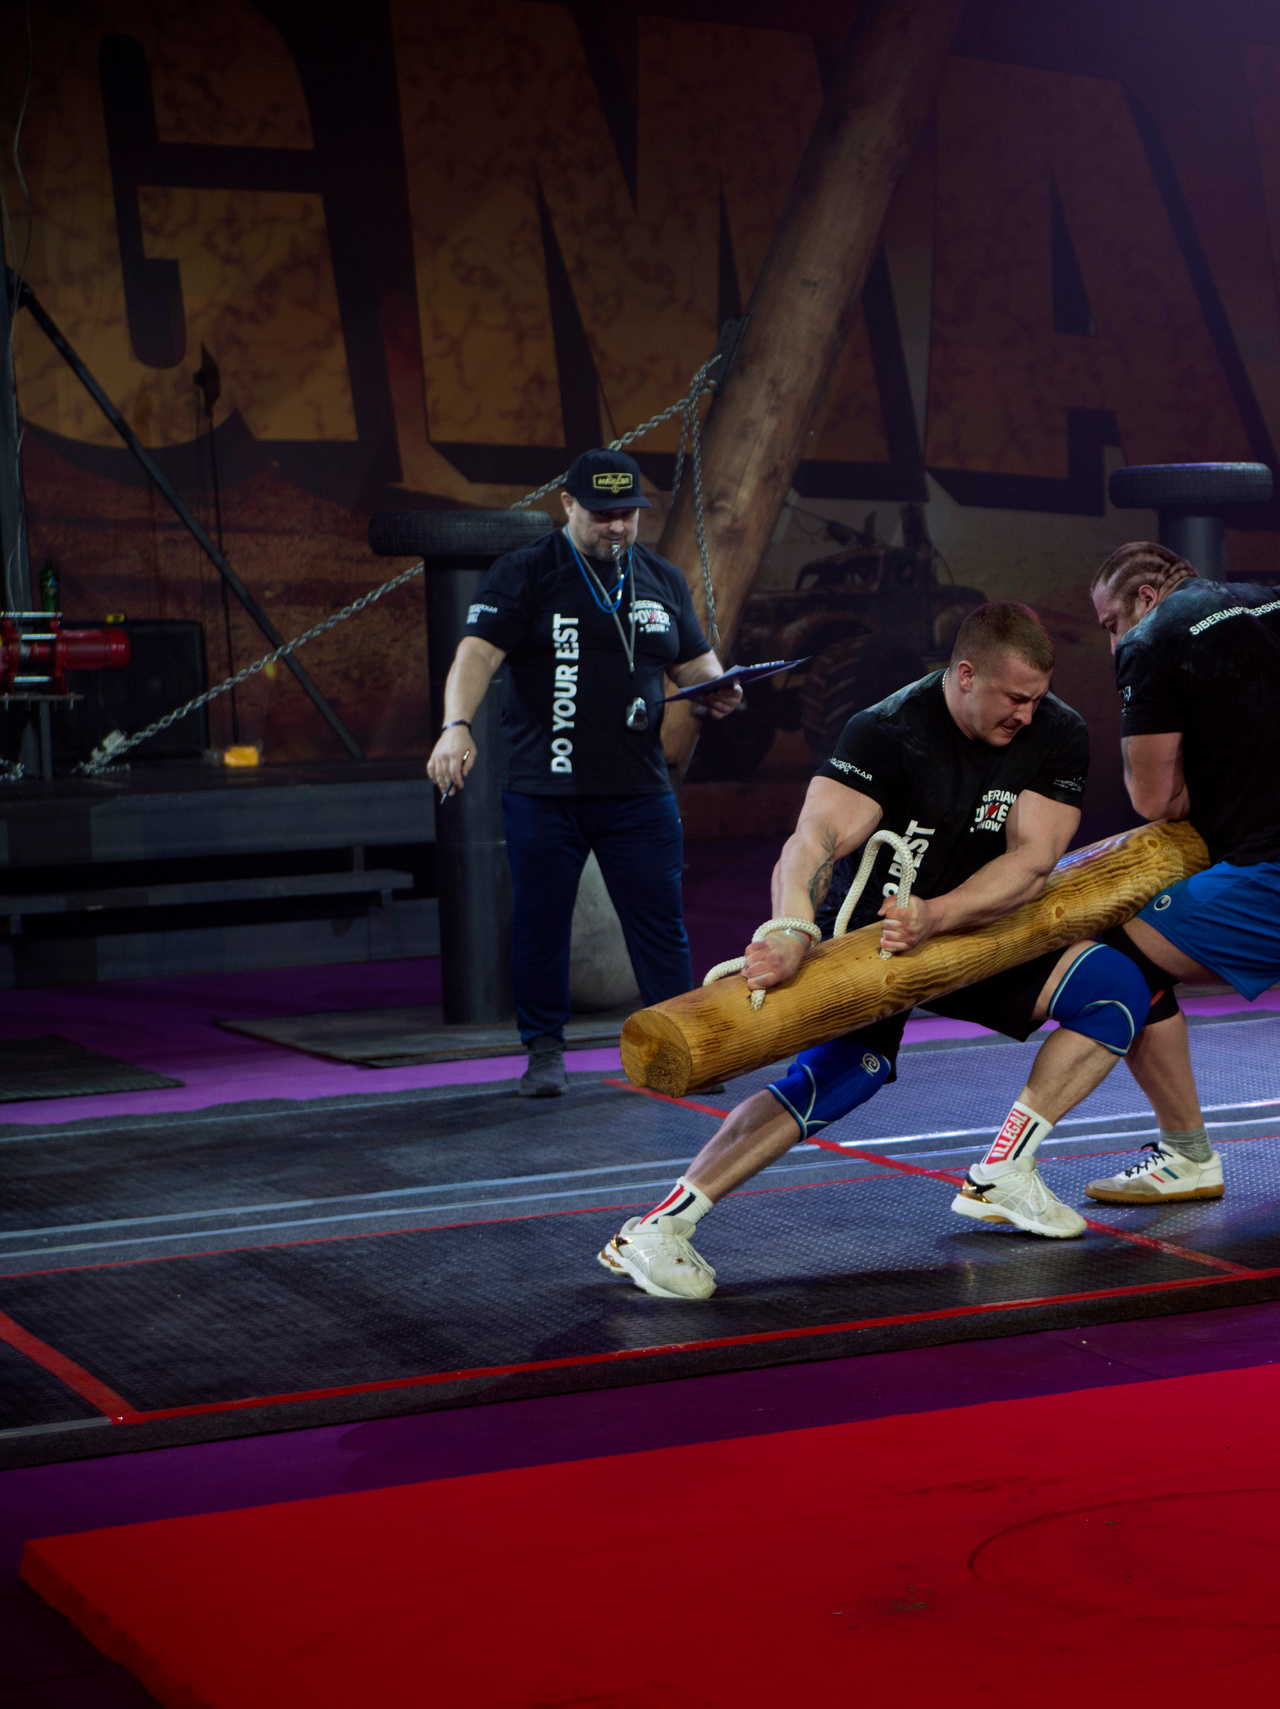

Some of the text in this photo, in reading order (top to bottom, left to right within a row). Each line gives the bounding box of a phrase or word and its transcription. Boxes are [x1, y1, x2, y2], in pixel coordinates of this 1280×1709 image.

[552, 664, 579, 733] YOUR
[551, 737, 573, 774] DO
[990, 1109, 1029, 1158] ILLEGAL
